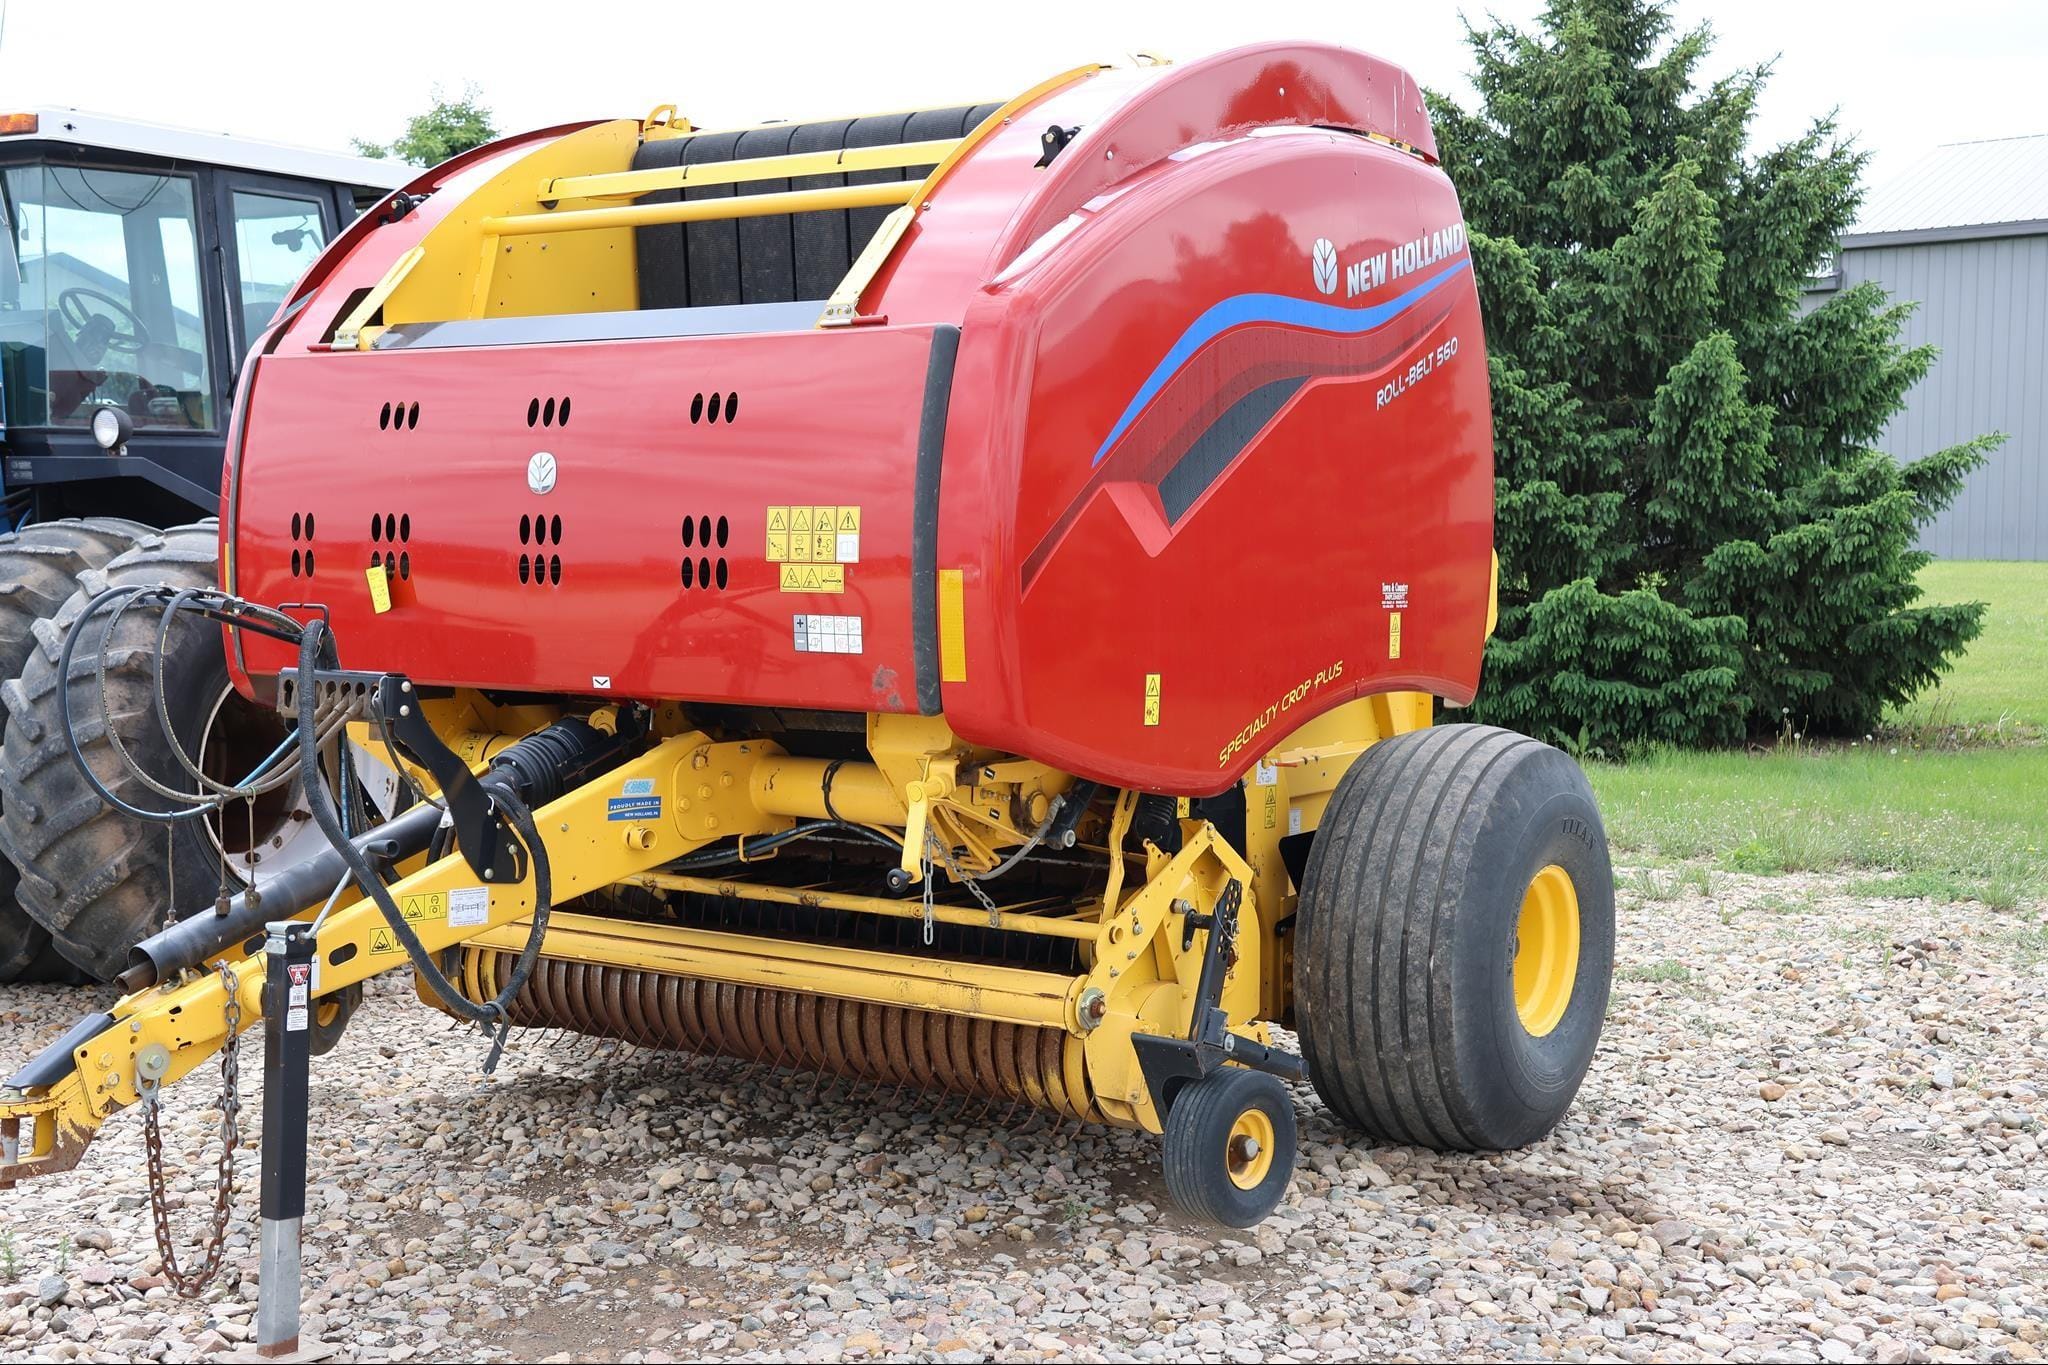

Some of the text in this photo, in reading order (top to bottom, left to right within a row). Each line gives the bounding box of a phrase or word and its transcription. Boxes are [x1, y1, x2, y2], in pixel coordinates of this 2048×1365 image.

[1346, 223, 1463, 299] NEW HOLLAND
[1376, 336, 1458, 411] ROLL-BELT 560
[1219, 660, 1344, 769] SPECIALTY CROP PLUS
[610, 802, 635, 810] PROUDLY
[1561, 817, 1597, 850] TITAN
